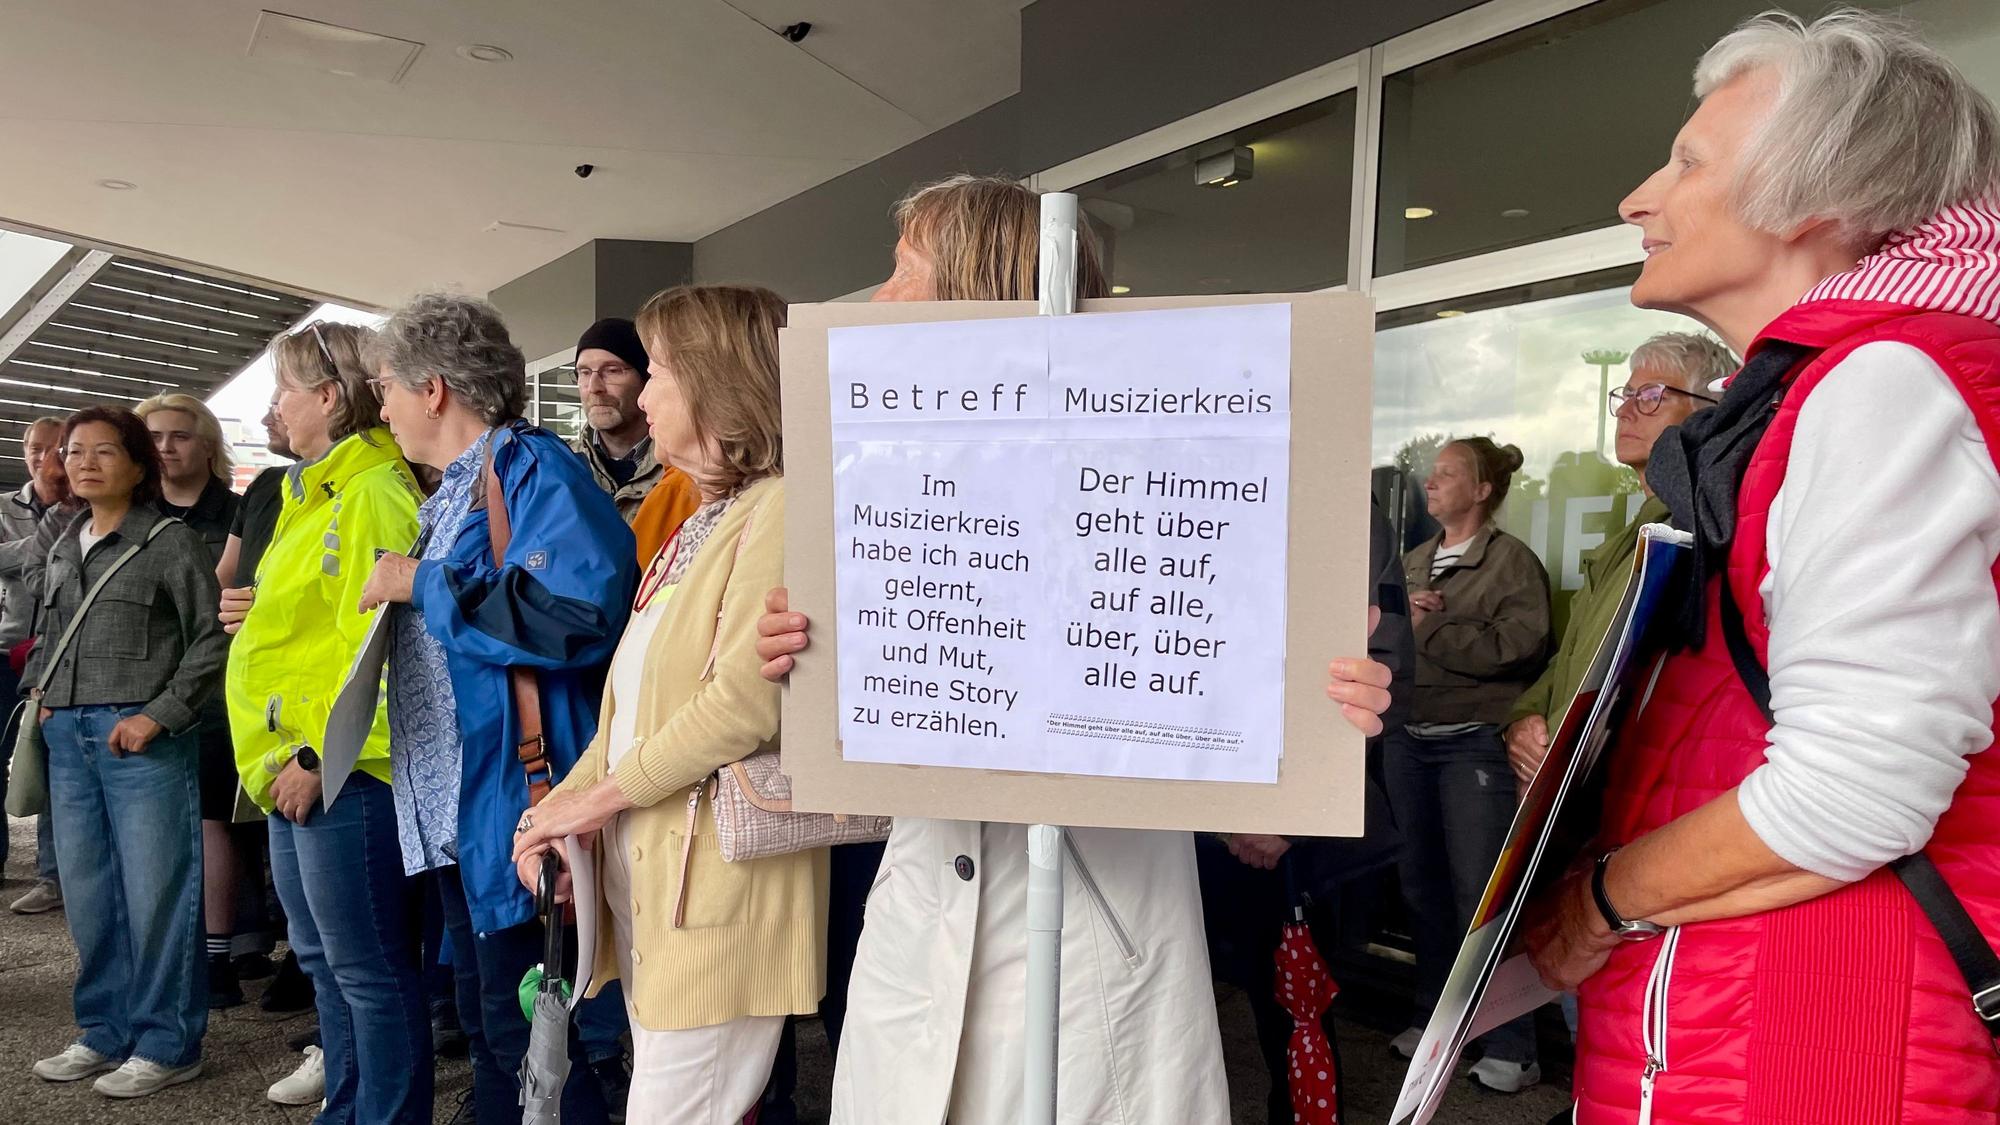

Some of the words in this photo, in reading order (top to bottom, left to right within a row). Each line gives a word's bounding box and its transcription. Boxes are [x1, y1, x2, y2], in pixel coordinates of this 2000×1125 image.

[850, 382, 1028, 412] Betreff
[1065, 386, 1272, 414] Musizierkreis
[921, 474, 956, 498] Im
[1079, 467, 1135, 495] Der
[1146, 470, 1268, 503] Himmel
[853, 503, 1020, 538] Musizierkreis
[1075, 507, 1145, 538] geht
[1157, 511, 1230, 541] über
[852, 536, 912, 563] habe
[922, 542, 957, 567] ich
[968, 549, 1029, 573] auch
[1094, 546, 1147, 575] alle
[1159, 553, 1217, 585] auf,
[885, 575, 983, 608] gelernt,
[1089, 587, 1141, 613] auf
[1149, 590, 1214, 625] alle,
[858, 607, 898, 629] mit
[907, 609, 1027, 641] Offenheit
[1066, 621, 1140, 657] über,
[1154, 629, 1227, 659] über
[882, 642, 928, 665] und
[939, 645, 994, 676] Mut,
[863, 675, 939, 699] meine
[949, 679, 1019, 712] Story
[1084, 662, 1137, 690] alle
[1148, 670, 1204, 696] auf.
[852, 706, 880, 725] zu
[890, 710, 1006, 739] erzählen.
[1062, 721, 1087, 730] Himmel
[1104, 725, 1119, 733] über
[1195, 734, 1211, 742] über
